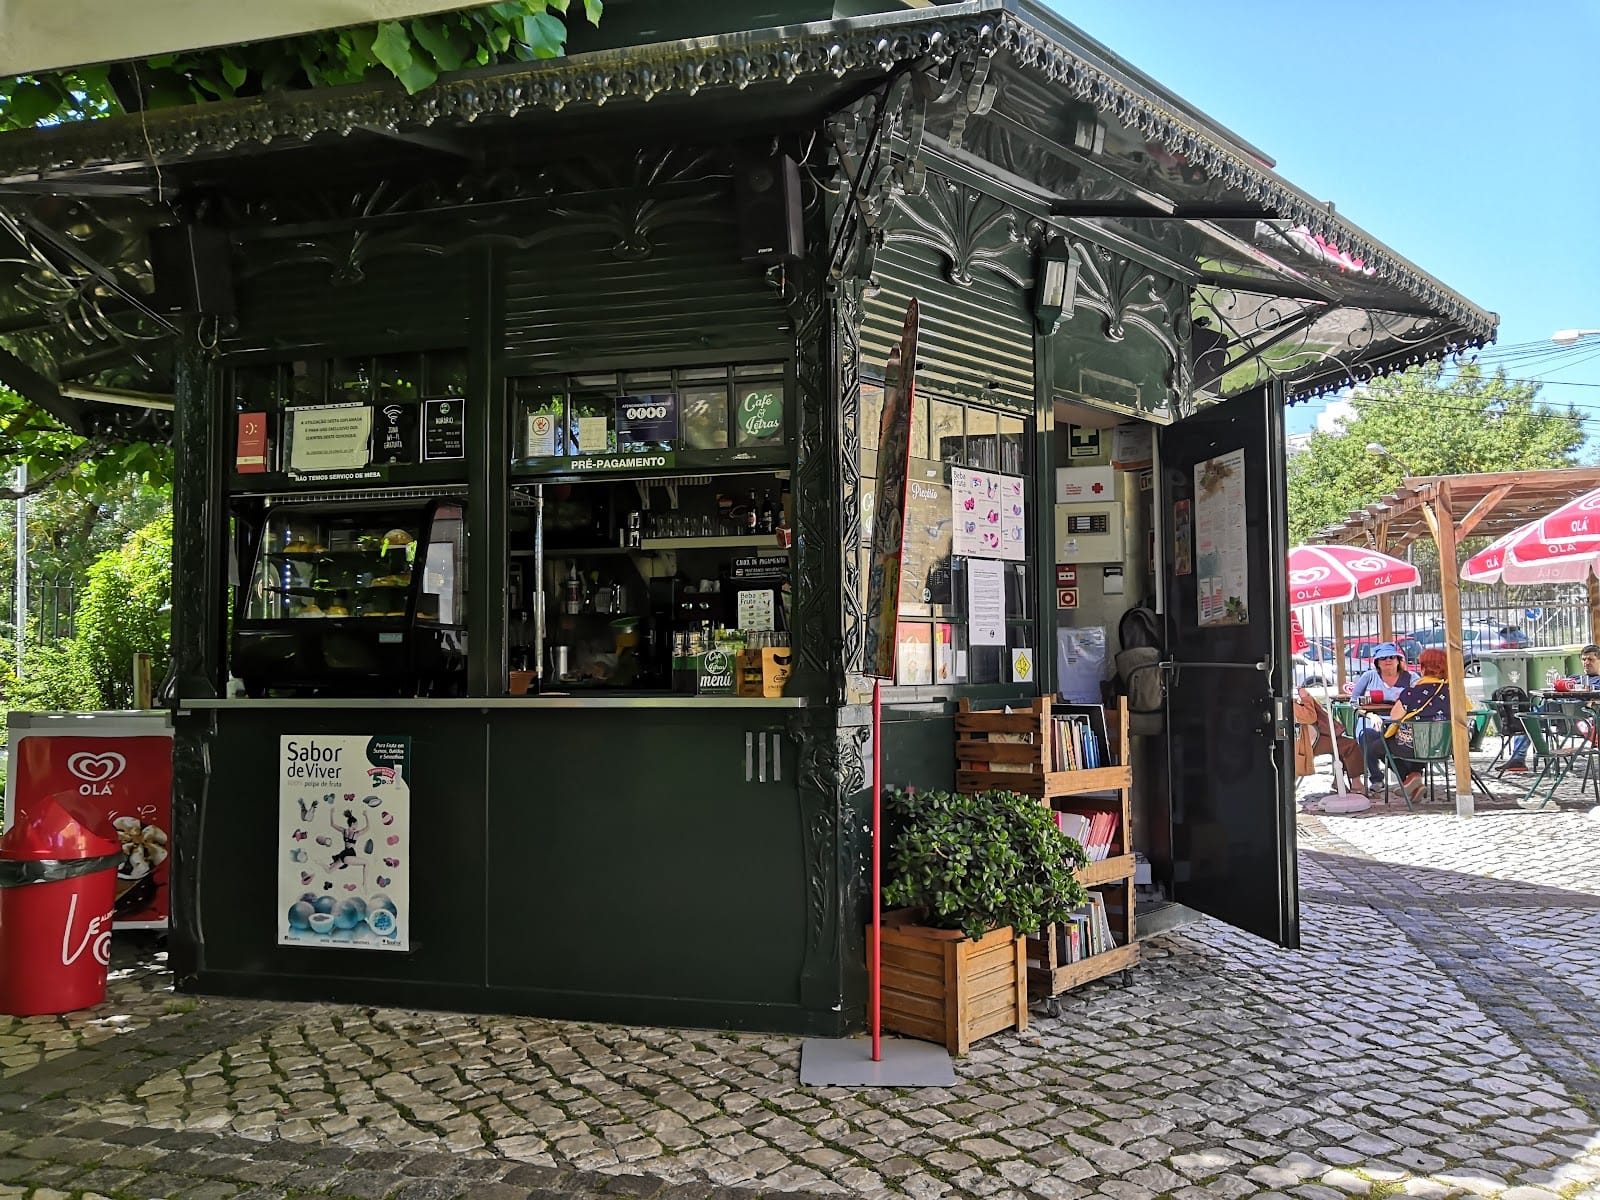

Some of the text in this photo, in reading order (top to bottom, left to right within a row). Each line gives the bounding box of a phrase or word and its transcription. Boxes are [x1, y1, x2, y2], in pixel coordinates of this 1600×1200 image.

[744, 392, 773, 412] Café
[757, 408, 766, 419] &
[745, 415, 780, 435] Letras
[571, 456, 666, 469] PRÉ-PAGAMENTO
[1571, 516, 1589, 532] OLÁ
[1486, 554, 1499, 569] OLÁ
[1374, 573, 1392, 586] OLÁ
[1296, 586, 1321, 600] OLÁ
[1298, 640, 1308, 648] OL
[700, 671, 732, 687] menú
[287, 740, 343, 762] Sabor
[79, 781, 113, 796] OLÁ
